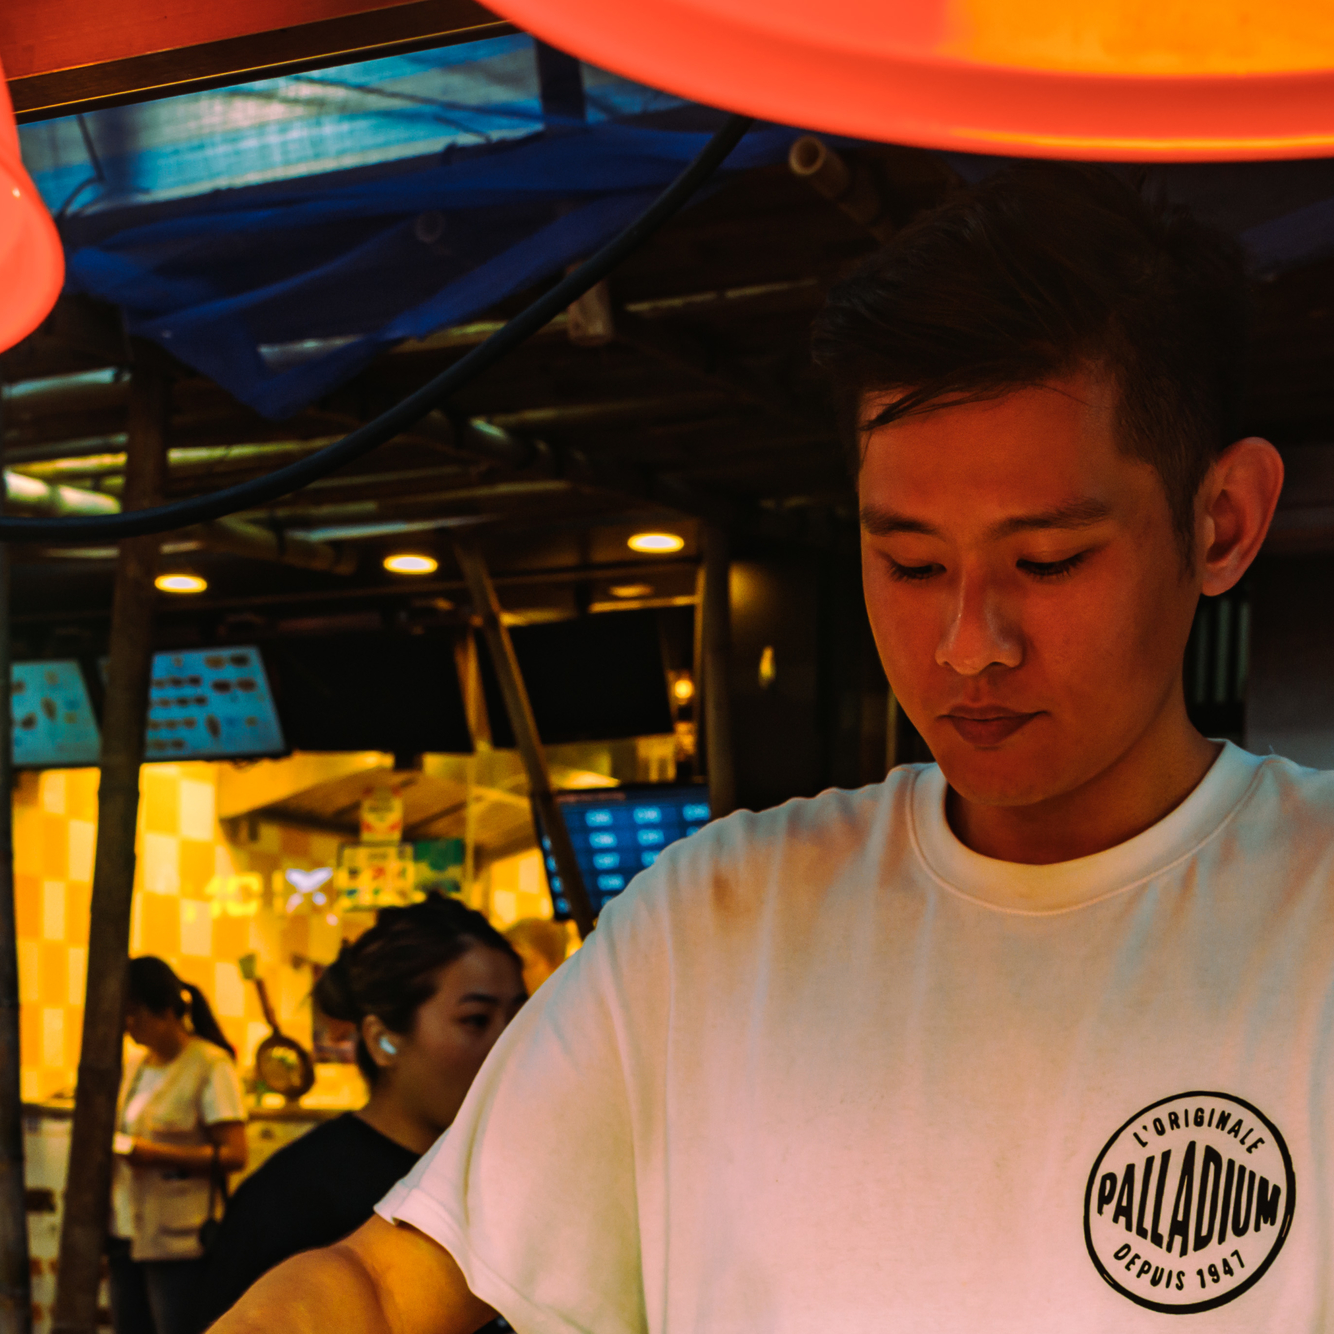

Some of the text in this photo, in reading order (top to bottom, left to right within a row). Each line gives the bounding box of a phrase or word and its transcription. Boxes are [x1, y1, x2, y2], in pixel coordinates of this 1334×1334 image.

[1132, 1107, 1265, 1154] L'ORIGINALE
[1097, 1140, 1281, 1258] PALLADIUM
[1113, 1243, 1245, 1291] DEPUIS 1947
